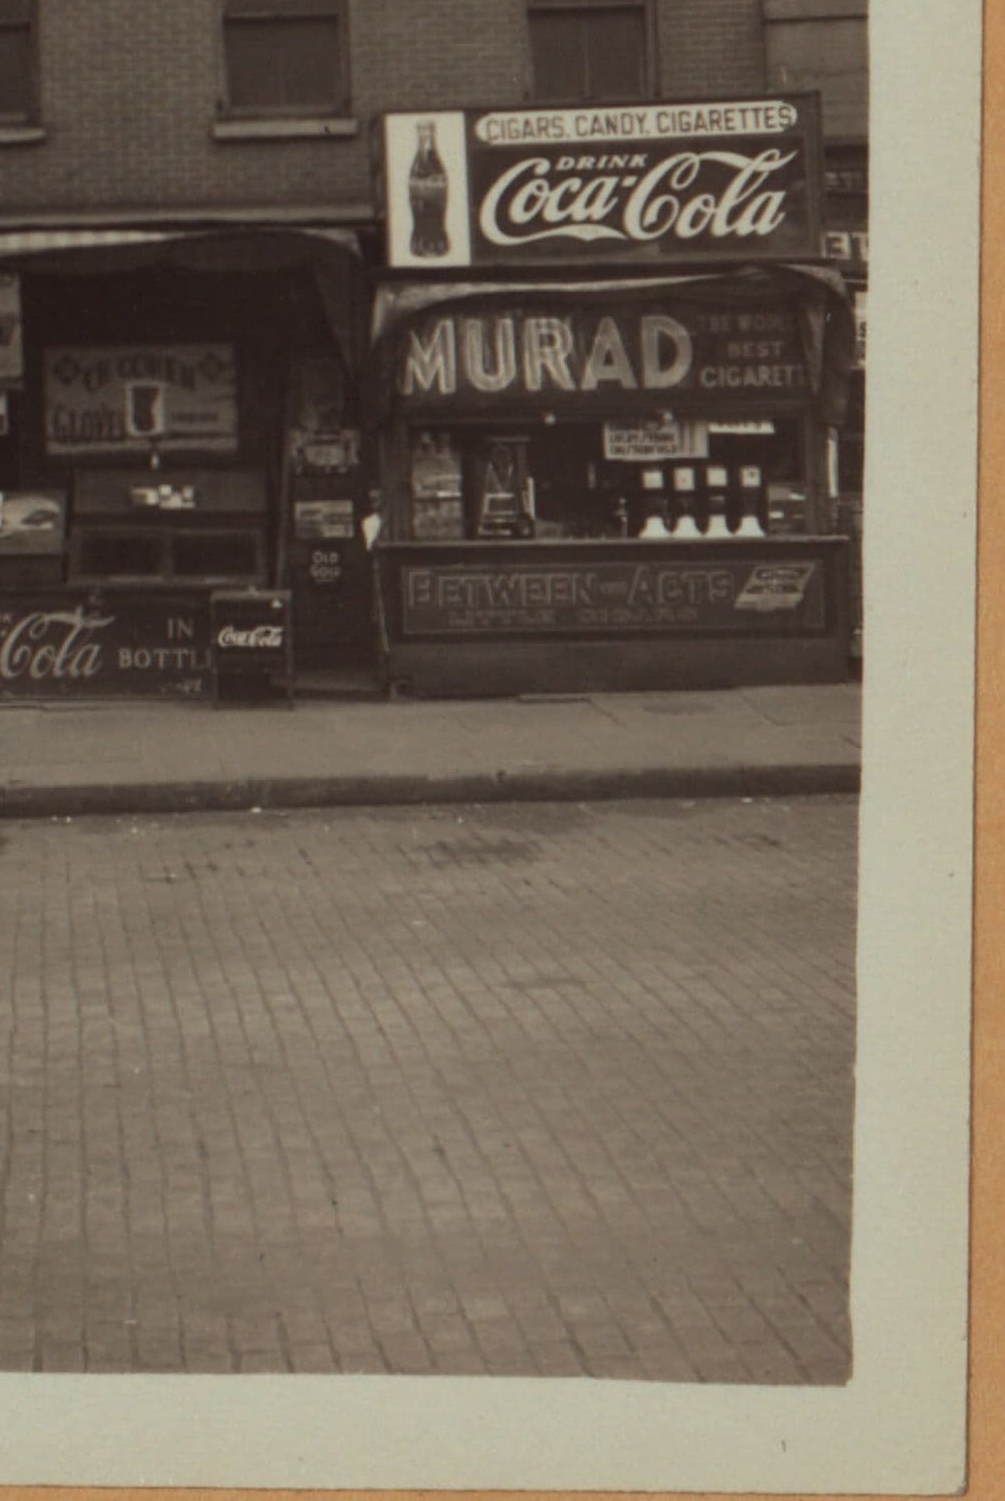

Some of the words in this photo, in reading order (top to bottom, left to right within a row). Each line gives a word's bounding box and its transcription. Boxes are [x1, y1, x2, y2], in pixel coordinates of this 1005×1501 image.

[655, 105, 794, 133] CIGARETTES
[556, 153, 648, 172] DRINK
[480, 148, 799, 246] Coca-Cola
[402, 313, 694, 396] MURAD
[727, 340, 786, 358] BEST
[407, 570, 597, 609] BETWEEN
[627, 564, 737, 606] ACTS
[167, 617, 194, 639] IN
[118, 647, 211, 670] BOTTL
